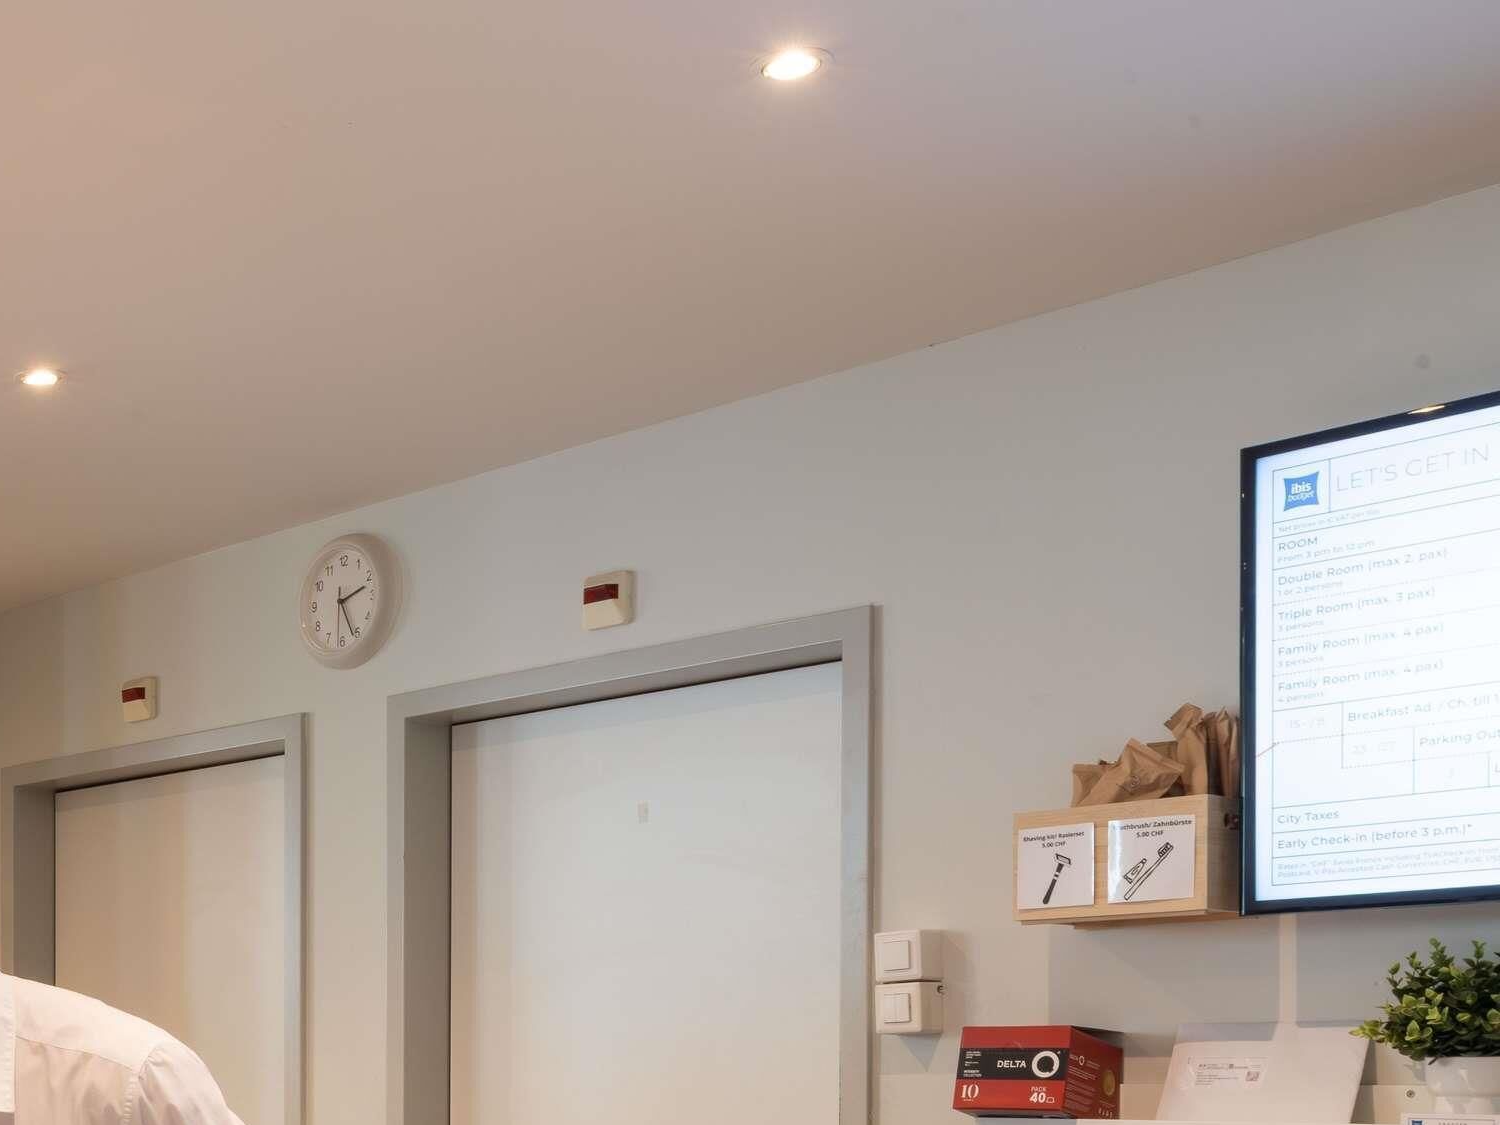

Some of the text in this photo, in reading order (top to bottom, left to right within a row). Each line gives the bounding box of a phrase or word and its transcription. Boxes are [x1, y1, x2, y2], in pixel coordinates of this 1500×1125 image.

[1335, 443, 1489, 492] LET'S GET IN
[1277, 536, 1319, 552] ROOM
[340, 555, 348, 567] 12
[325, 565, 334, 577] 11
[367, 570, 372, 581] 2
[1277, 569, 1323, 586] Double
[1327, 562, 1364, 577] Room
[315, 580, 324, 592] 10
[312, 602, 318, 613] 9
[1277, 608, 1313, 623] Triple
[1316, 600, 1354, 615] Room
[315, 621, 321, 632] 8
[354, 627, 360, 638] 5
[326, 632, 331, 644] 7
[340, 636, 346, 647] 6
[1277, 640, 1318, 656] Family
[1322, 635, 1360, 650] Room
[1277, 677, 1318, 693] Family
[1322, 672, 1360, 687] Room
[1348, 704, 1410, 722] Breakfast
[1419, 731, 1473, 748] Parking
[1153, 818, 1192, 828] Zahnbürste
[1276, 809, 1340, 826] City Taxes
[1023, 833, 1046, 844] Shaving
[1277, 839, 1307, 850] Early
[1311, 832, 1368, 847] Check-in
[1371, 826, 1418, 842] (before
[1421, 826, 1429, 837] 3
[996, 1060, 1027, 1068] DELTA
[960, 1084, 980, 1099] 10
[1029, 1092, 1046, 1104] 40
